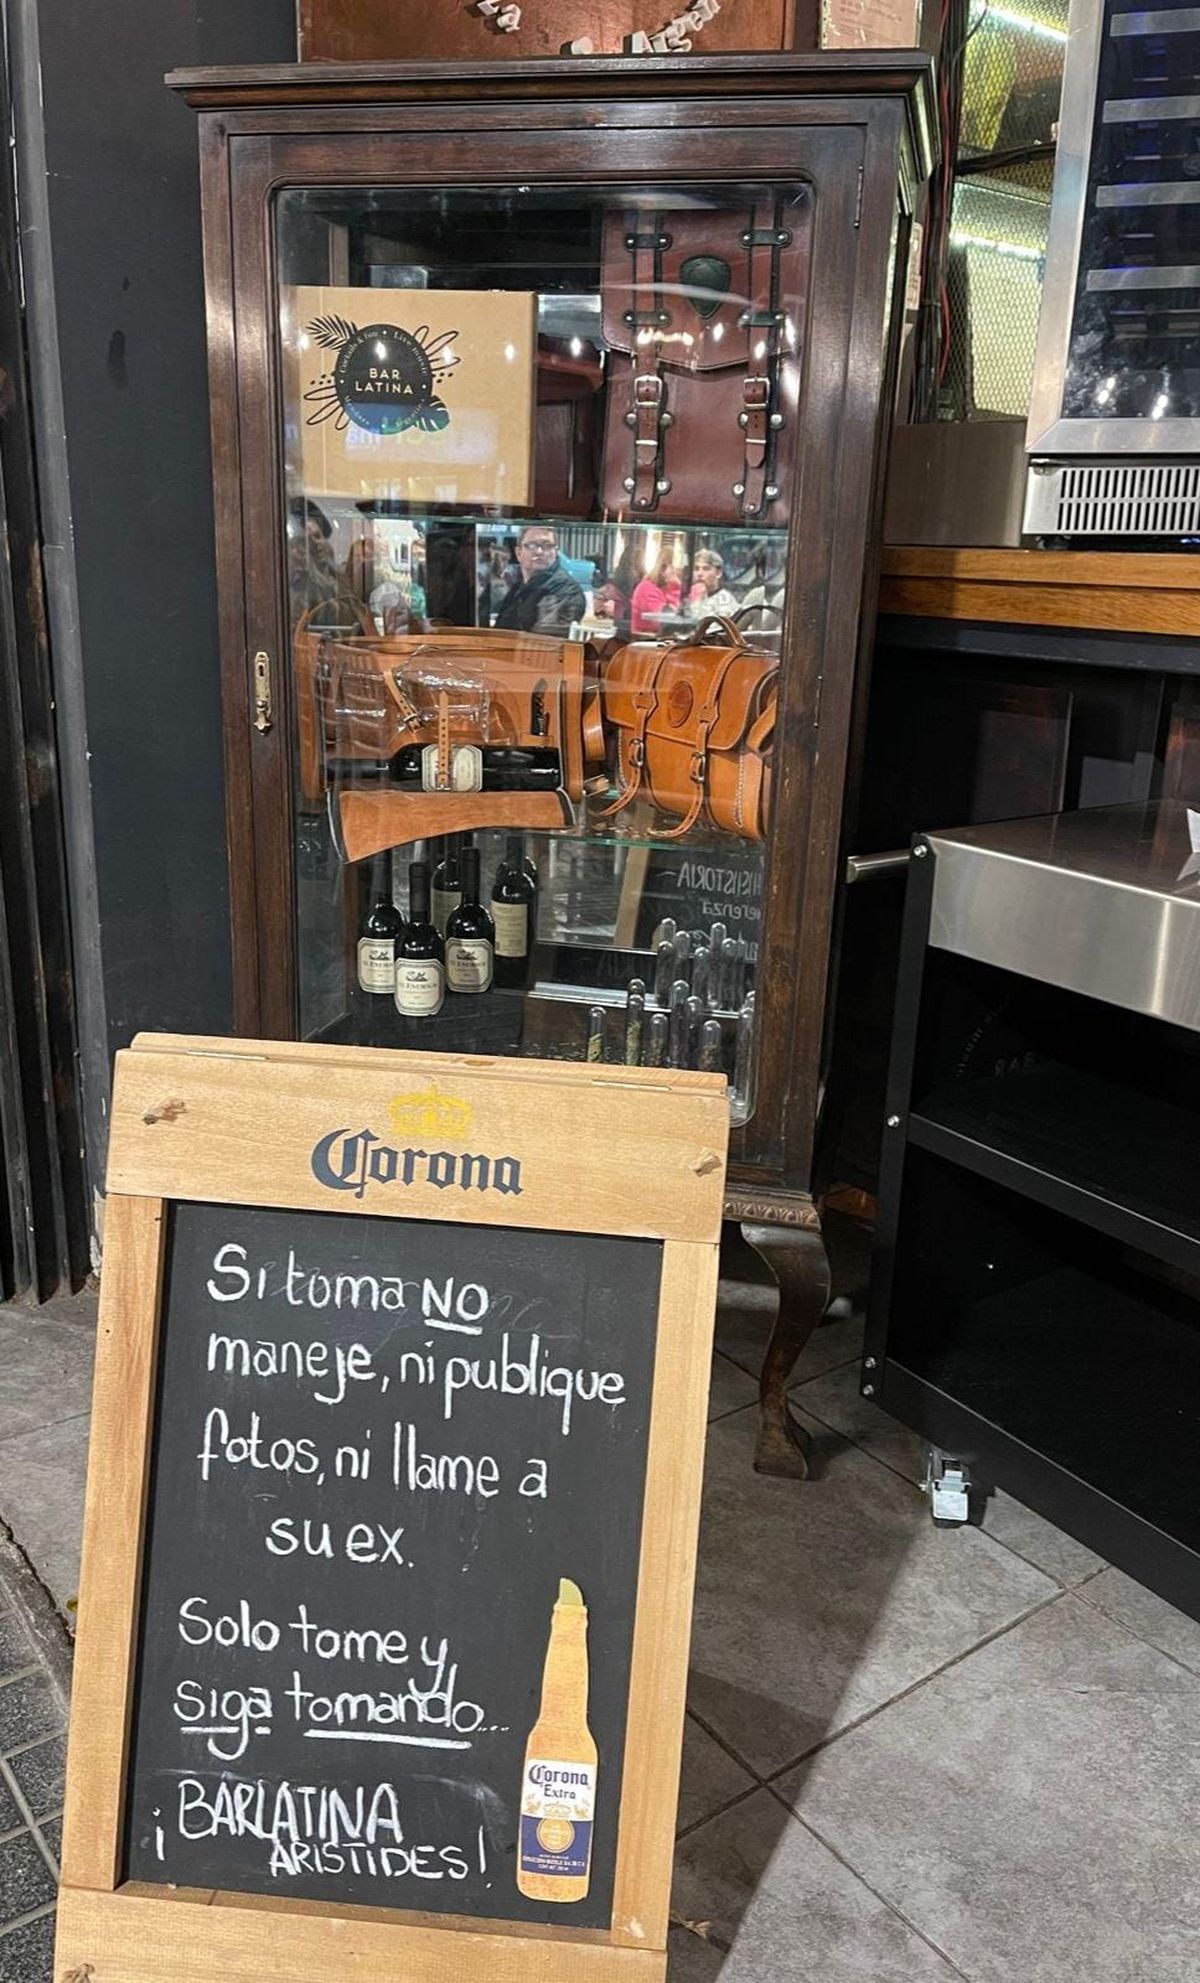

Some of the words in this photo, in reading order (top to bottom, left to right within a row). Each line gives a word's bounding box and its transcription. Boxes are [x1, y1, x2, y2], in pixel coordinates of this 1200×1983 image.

[355, 381, 413, 395] LATINA
[369, 367, 401, 380] BAR
[311, 1128, 523, 1199] Corona
[207, 1243, 267, 1301] Si
[286, 1250, 405, 1311] toma
[422, 1277, 489, 1322] NO
[208, 1333, 390, 1405] maneje,
[400, 1340, 435, 1385] ni
[444, 1332, 626, 1436] publique
[197, 1407, 325, 1486] fotos,
[335, 1429, 371, 1480] ni
[392, 1421, 500, 1498] llame
[518, 1458, 548, 1498] a
[265, 1517, 335, 1559] su
[346, 1523, 416, 1568] ex.
[178, 1596, 281, 1652] Solo
[288, 1604, 410, 1665] tome
[408, 1635, 449, 1698] y
[528, 1764, 590, 1788] Corona
[544, 1784, 577, 1800] Extra
